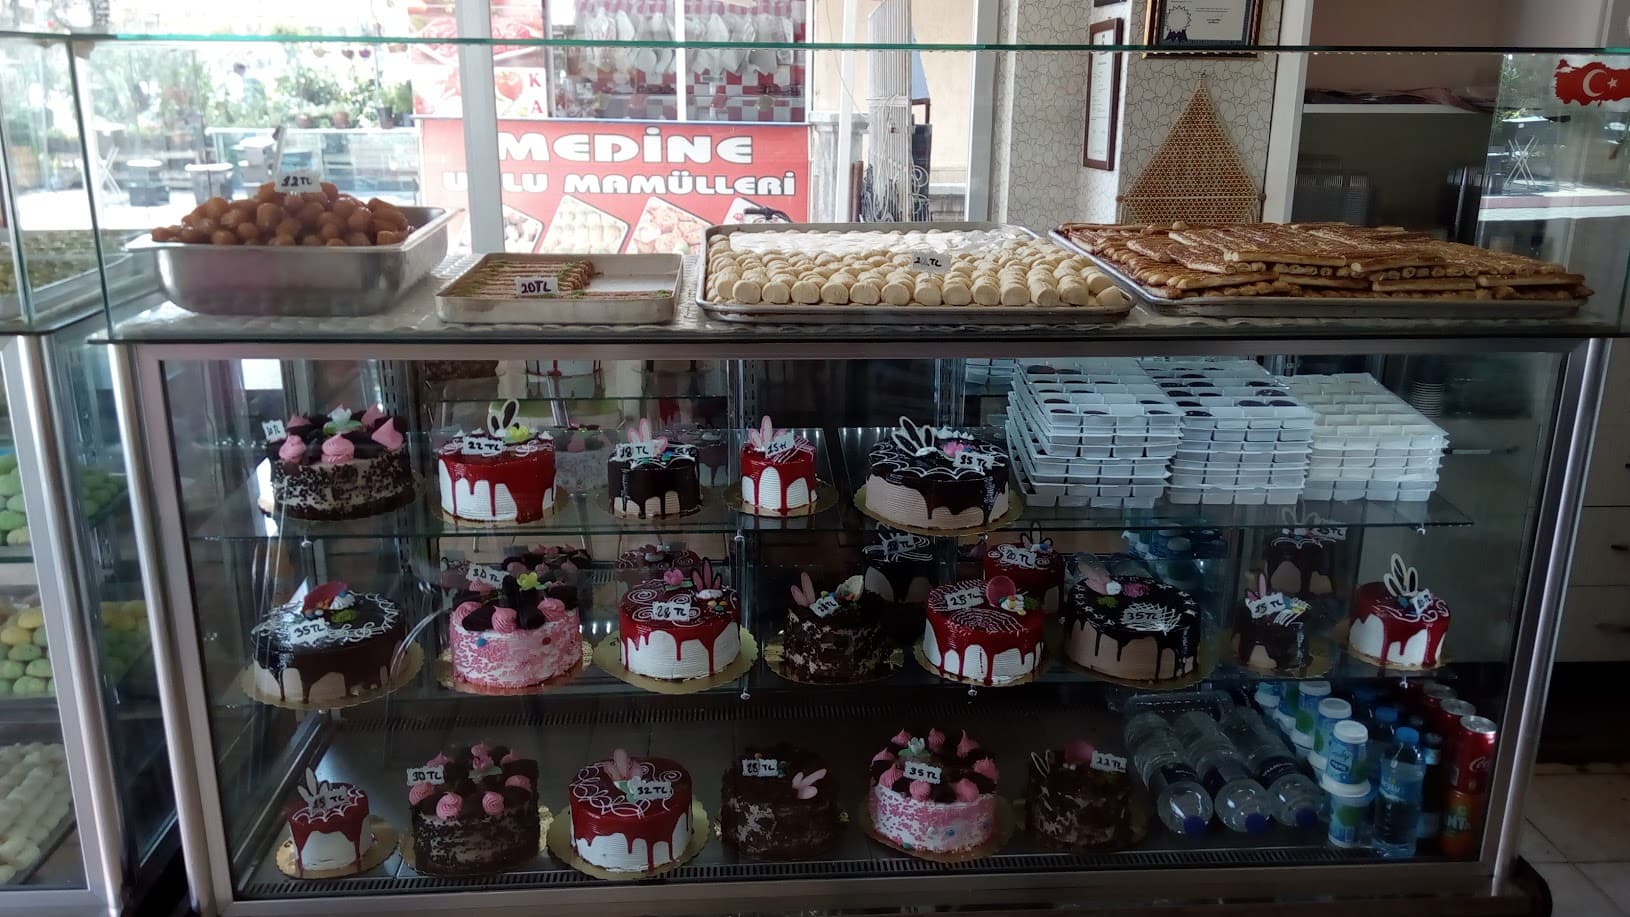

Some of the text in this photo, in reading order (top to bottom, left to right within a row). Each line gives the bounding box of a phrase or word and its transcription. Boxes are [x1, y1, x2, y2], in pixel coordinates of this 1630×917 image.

[498, 127, 754, 165] MEDİNE
[443, 170, 796, 196] ULU MAMÜLLERİ
